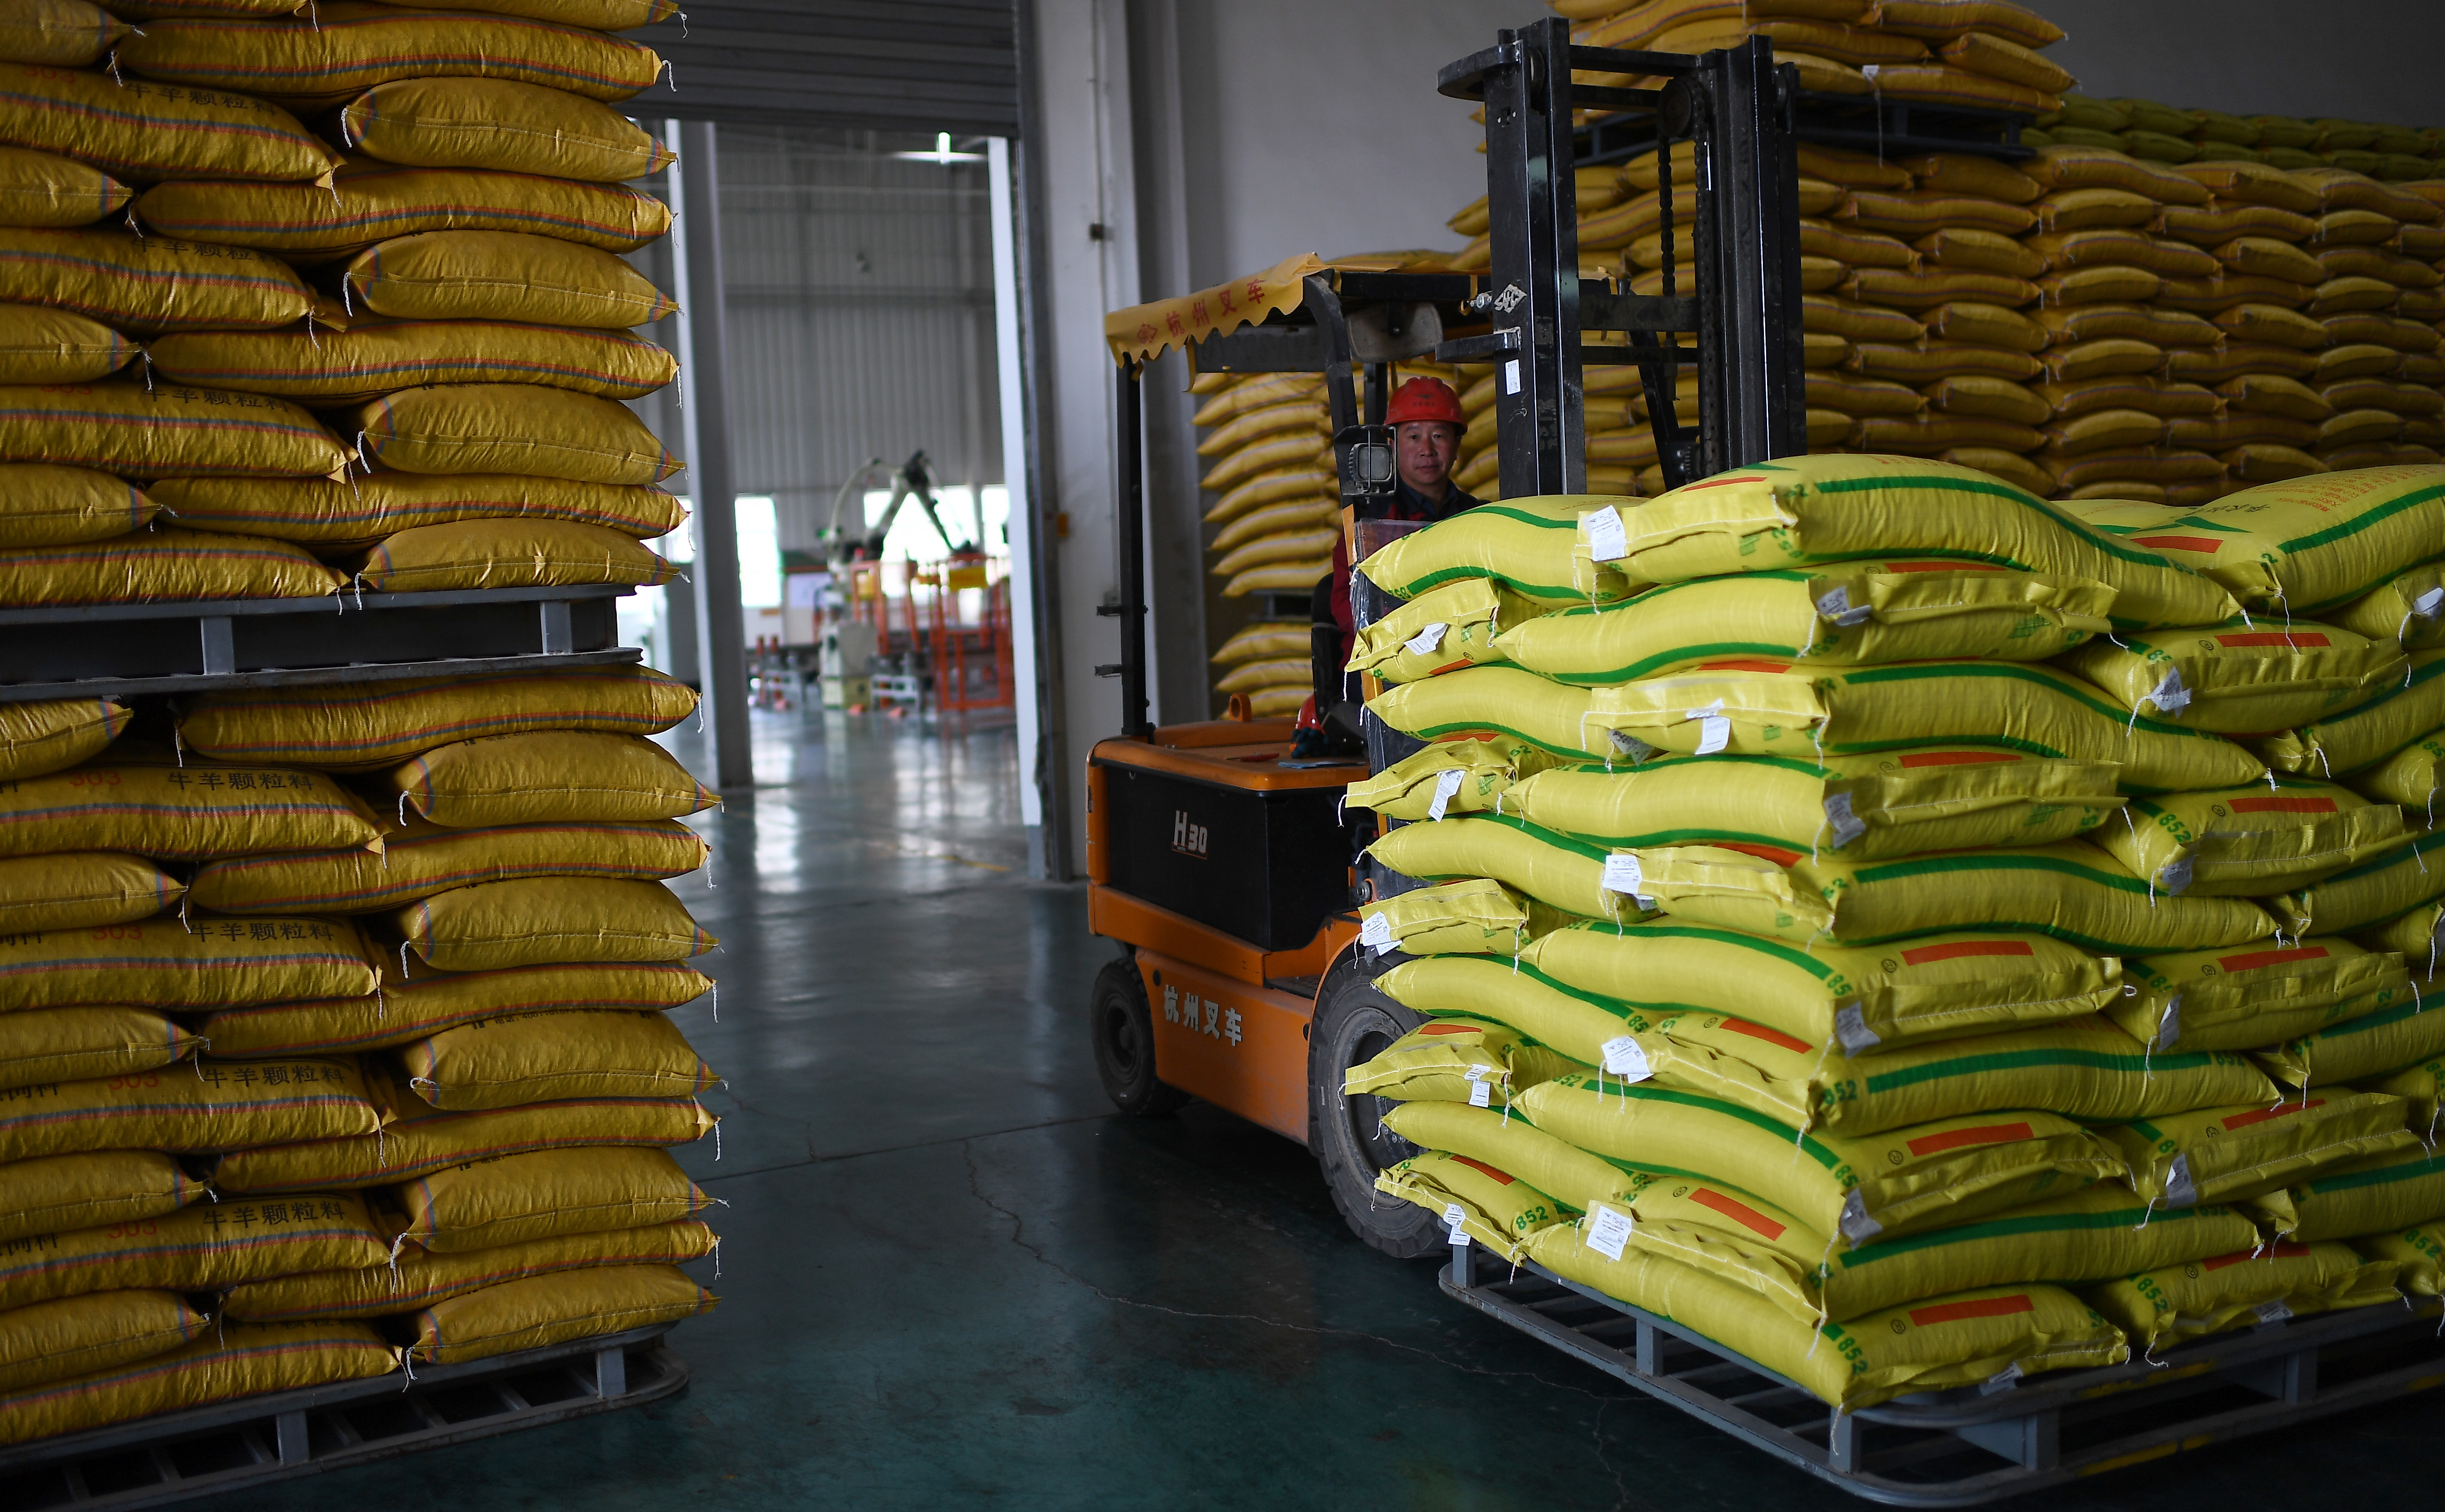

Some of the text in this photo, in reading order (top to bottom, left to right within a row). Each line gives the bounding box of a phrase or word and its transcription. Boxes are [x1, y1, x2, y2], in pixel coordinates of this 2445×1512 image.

[1166, 278, 1265, 337] 杭州叉车
[68, 770, 315, 791] 303 牛羊颗粒料
[1173, 809, 1208, 854] H30
[2159, 814, 2196, 843] 852
[190, 923, 333, 943] 牛羊颗粒料
[1164, 984, 1243, 1047] 杭州叉车
[204, 1065, 345, 1089] 牛羊颗粒料
[108, 1218, 158, 1239] 303
[203, 1201, 345, 1232] 牛羊颗粒料
[1515, 1205, 1549, 1230] 852
[2405, 1229, 2441, 1259] 852
[2137, 1278, 2168, 1313] 852
[1838, 1338, 1867, 1376] 852
